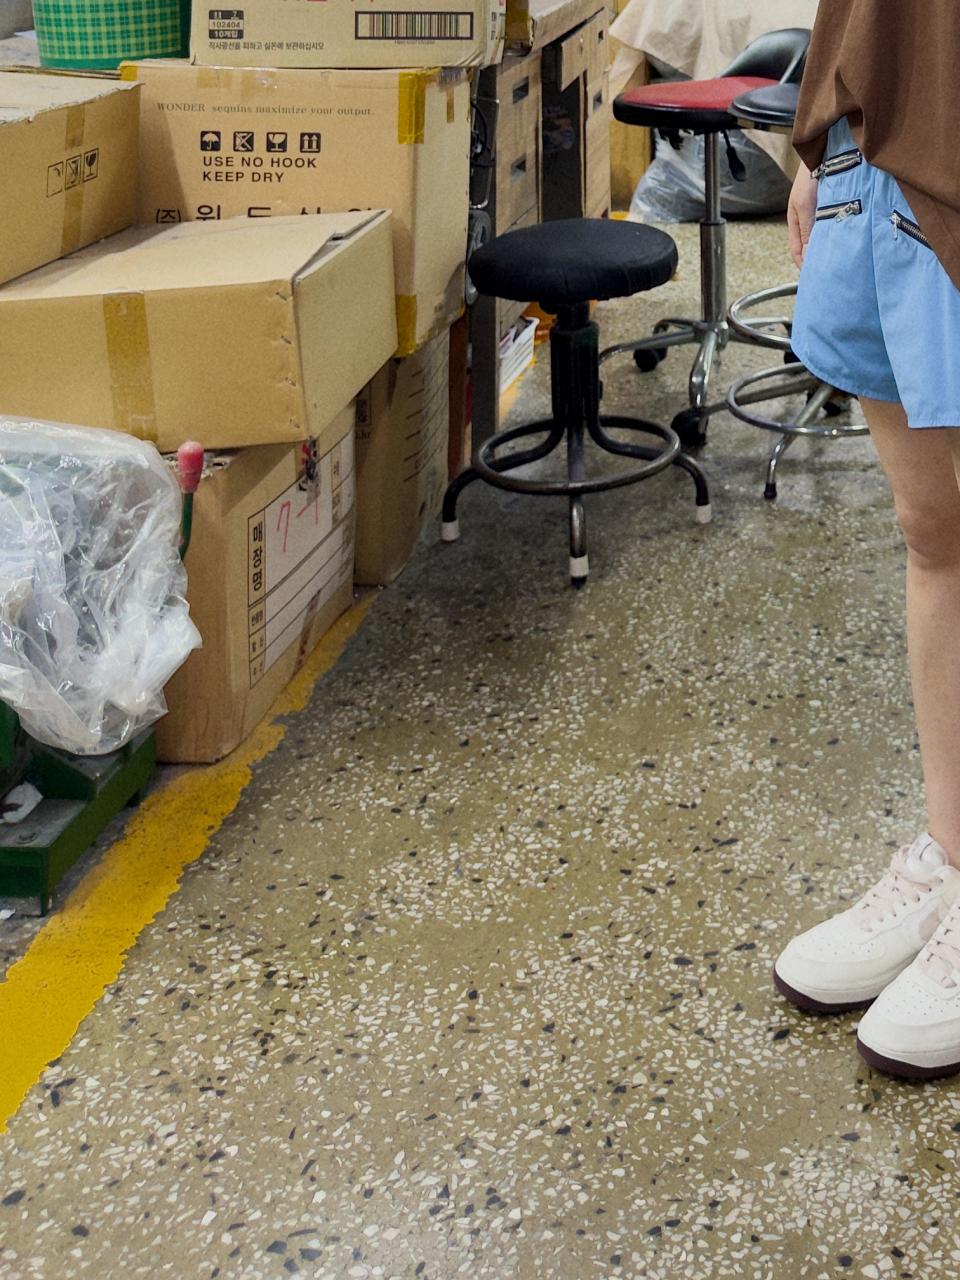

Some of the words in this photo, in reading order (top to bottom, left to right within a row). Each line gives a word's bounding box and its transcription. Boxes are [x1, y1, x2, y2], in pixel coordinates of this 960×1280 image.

[156, 102, 206, 112] WONDER
[203, 156, 234, 167] USE
[241, 156, 264, 167] NO
[270, 157, 317, 168] HOOK
[203, 171, 245, 182] KEEP
[251, 172, 285, 183] DRY
